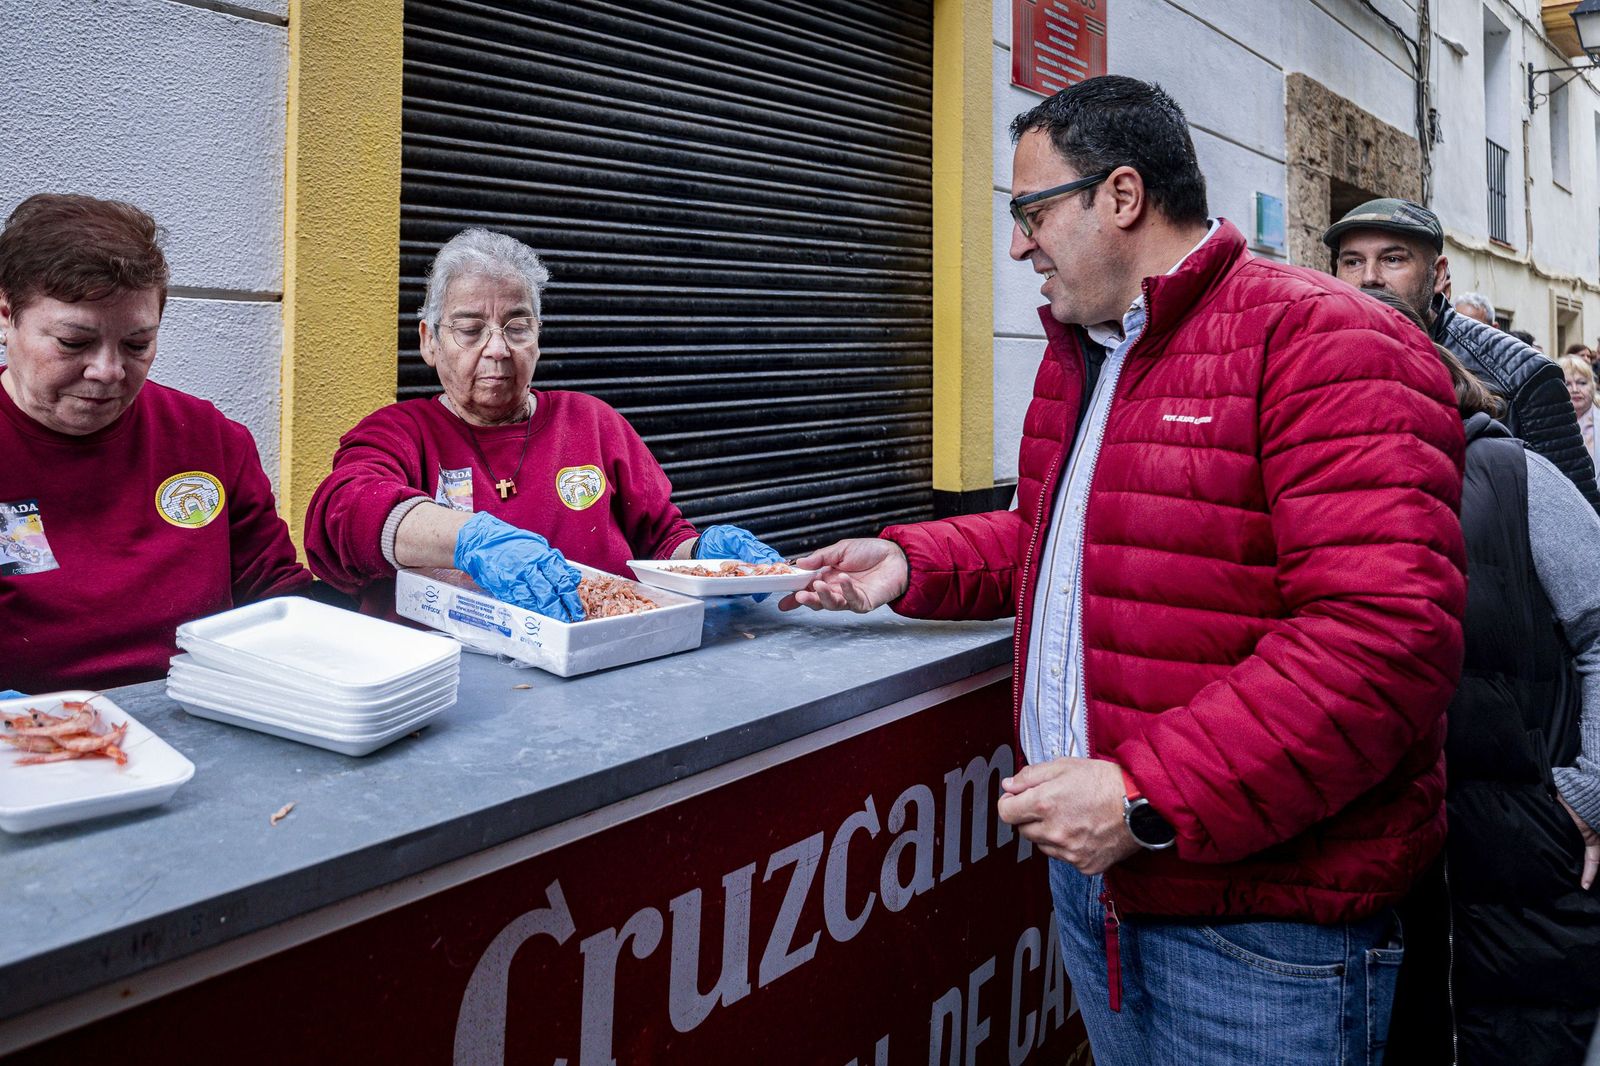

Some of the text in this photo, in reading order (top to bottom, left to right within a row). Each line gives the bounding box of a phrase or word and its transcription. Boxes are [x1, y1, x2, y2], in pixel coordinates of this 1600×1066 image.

[453, 743, 1032, 1066] Cruzcam
[928, 908, 1081, 1066] DE CA
